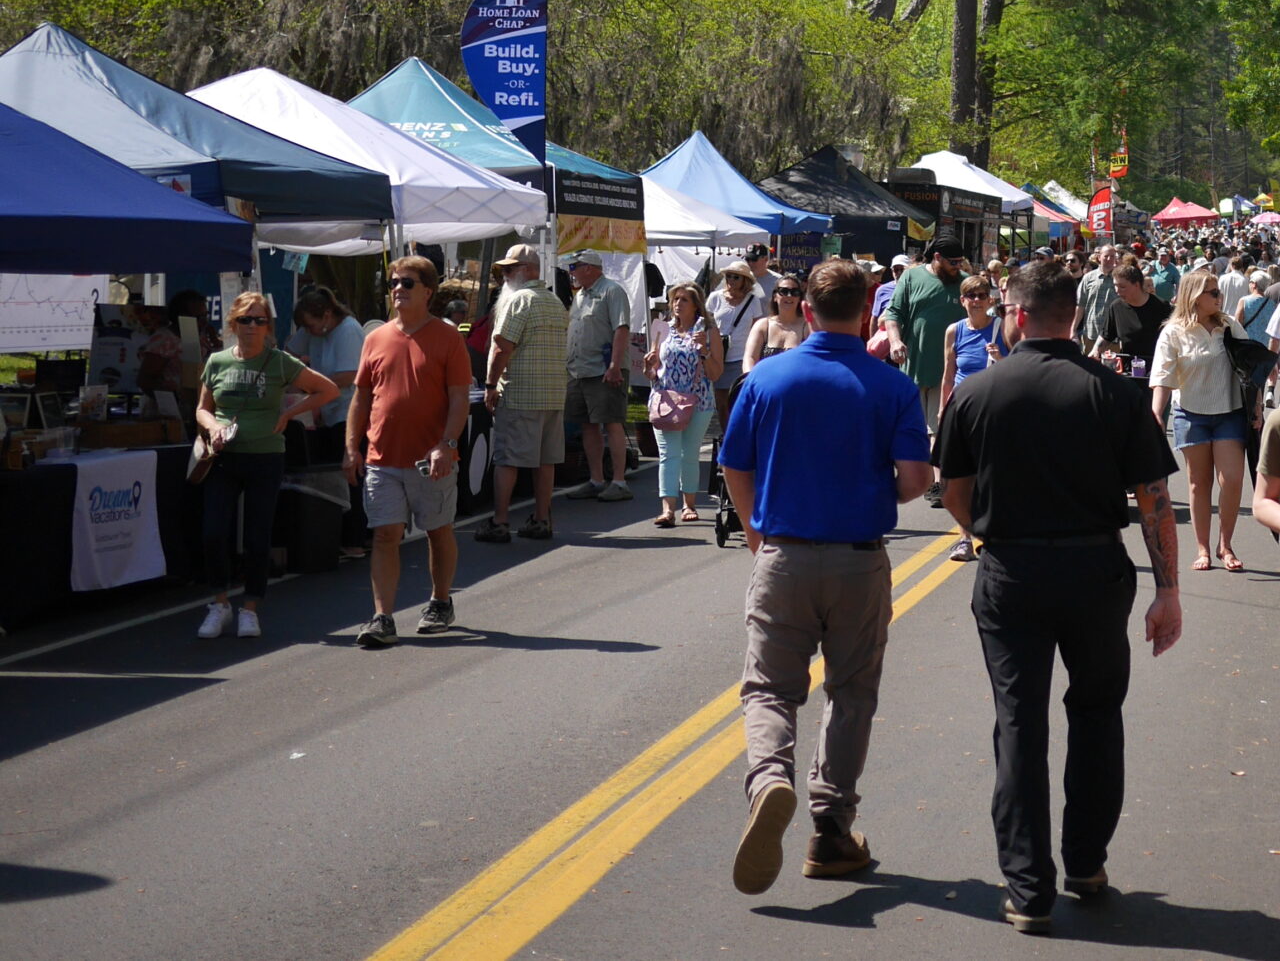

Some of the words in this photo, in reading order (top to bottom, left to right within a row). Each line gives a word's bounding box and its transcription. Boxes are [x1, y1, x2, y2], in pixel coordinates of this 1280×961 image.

[484, 44, 540, 58] Build.
[497, 60, 540, 76] Buy.
[494, 92, 540, 106] Refi.
[904, 191, 938, 201] FUSION
[88, 486, 133, 512] Dream
